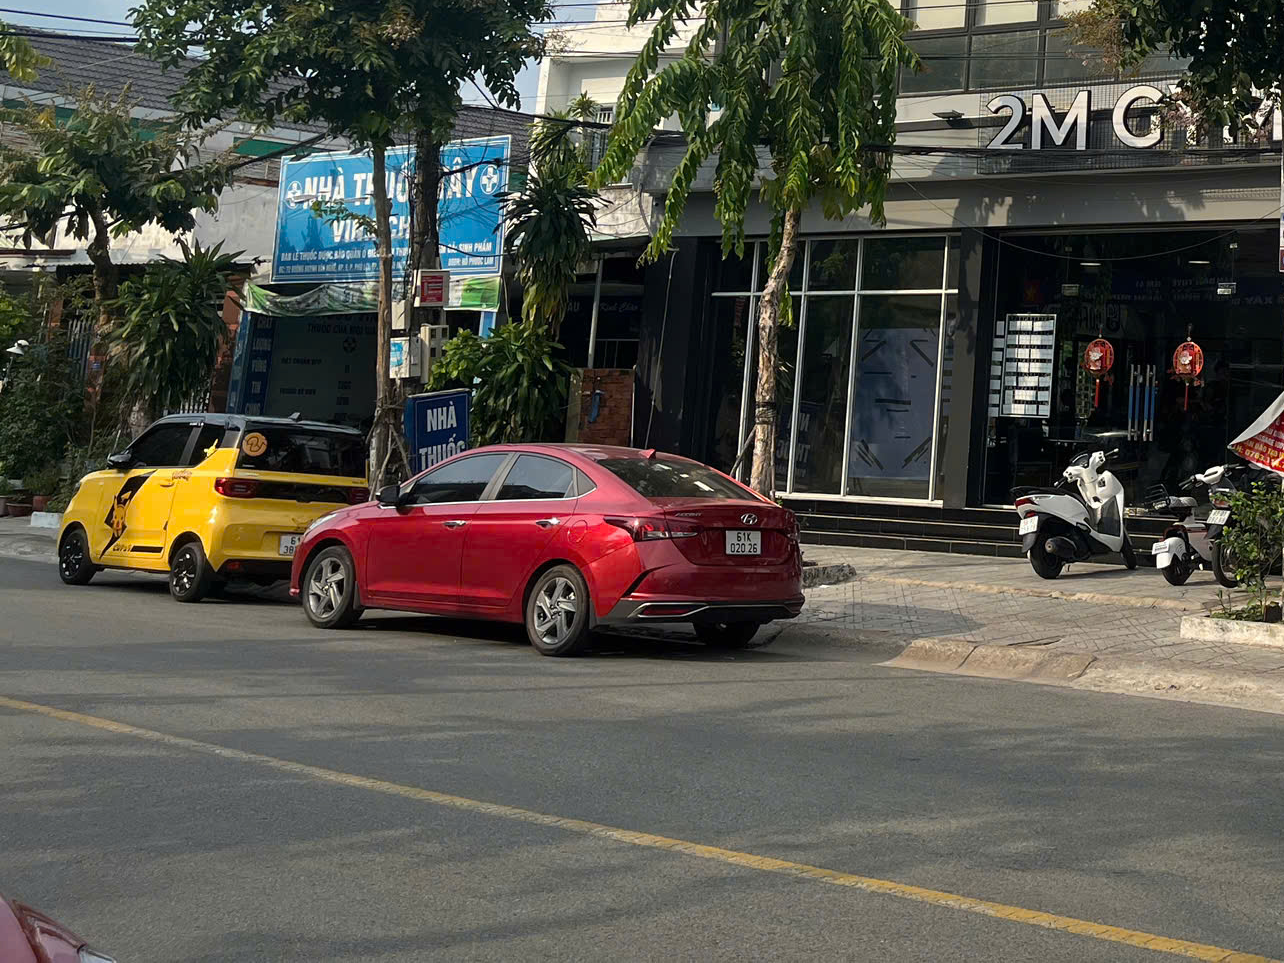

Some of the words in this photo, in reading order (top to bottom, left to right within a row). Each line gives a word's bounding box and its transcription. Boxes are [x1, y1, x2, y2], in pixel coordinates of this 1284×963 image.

[985, 90, 1091, 150] 2M
[303, 167, 345, 209] NHÀ
[427, 400, 457, 432] NHÀ
[736, 531, 752, 543] 61K
